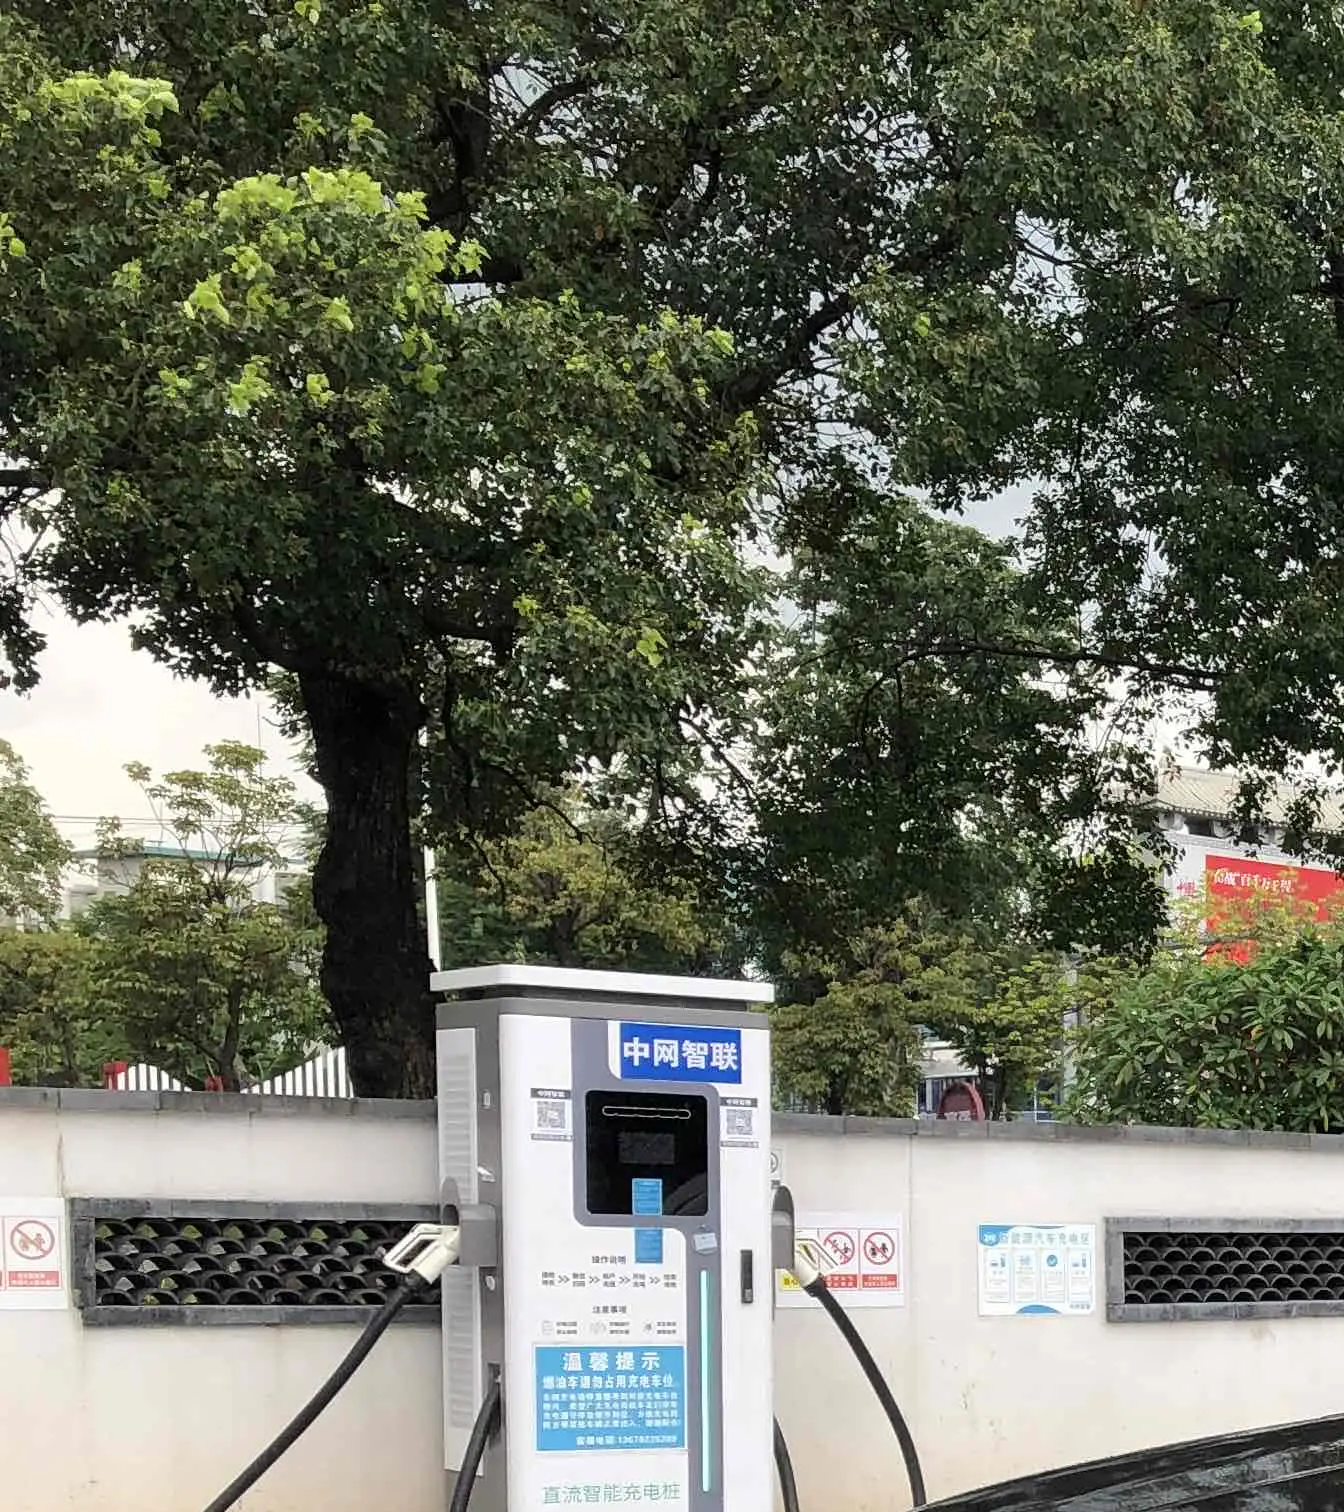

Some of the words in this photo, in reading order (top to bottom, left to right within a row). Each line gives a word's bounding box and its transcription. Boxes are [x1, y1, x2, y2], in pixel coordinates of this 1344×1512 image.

[623, 1036, 738, 1071] 中网智联
[562, 1351, 661, 1372] 温馨提示
[542, 1481, 682, 1505] 直流智能充电桩
